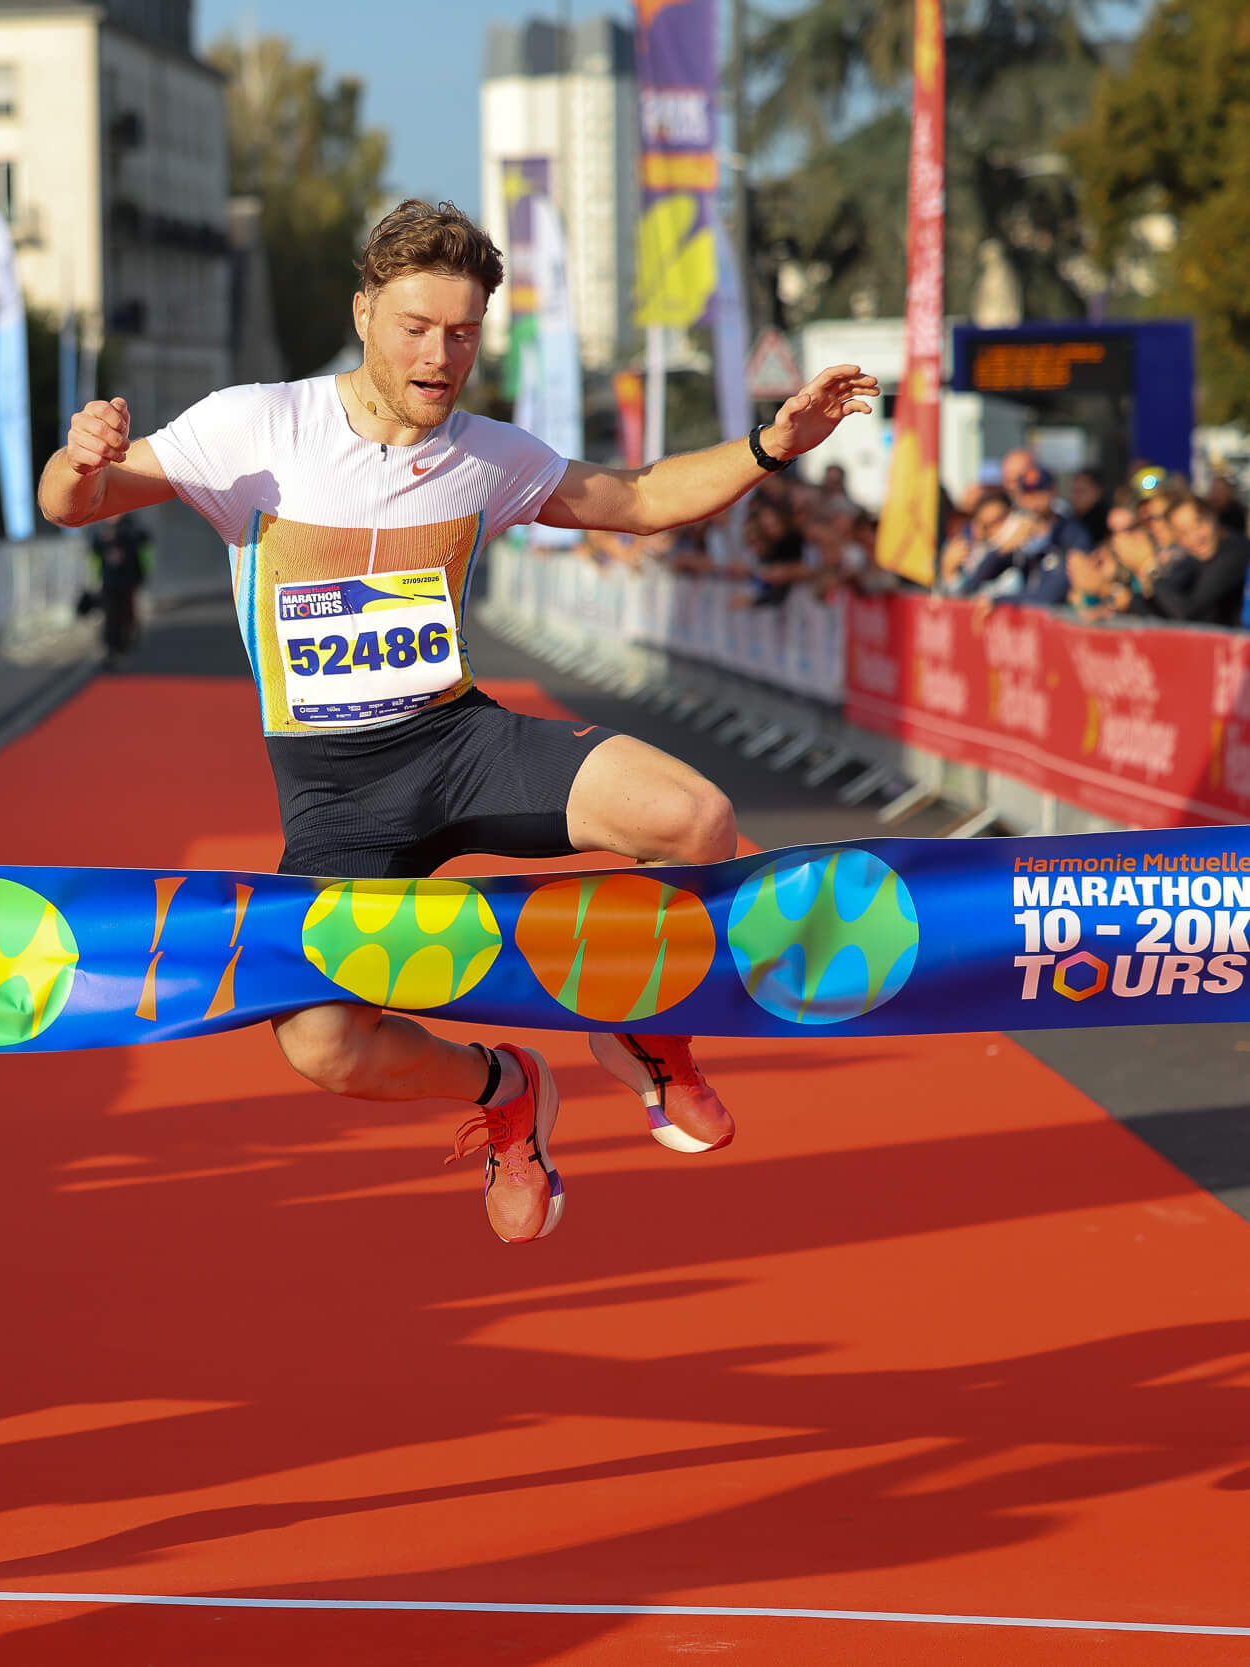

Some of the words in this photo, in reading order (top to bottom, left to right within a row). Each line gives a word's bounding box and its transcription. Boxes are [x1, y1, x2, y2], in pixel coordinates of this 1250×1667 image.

[282, 591, 342, 605] MARATHON
[288, 600, 343, 618] TOURS
[287, 623, 450, 676] 52486
[1014, 854, 1137, 873] Harmonie
[1143, 852, 1250, 872] Mutuelle
[1013, 876, 1250, 907] MARATHON
[1014, 908, 1081, 952] 10
[1136, 908, 1250, 953] 20K
[1013, 951, 1248, 1002] TOURS
